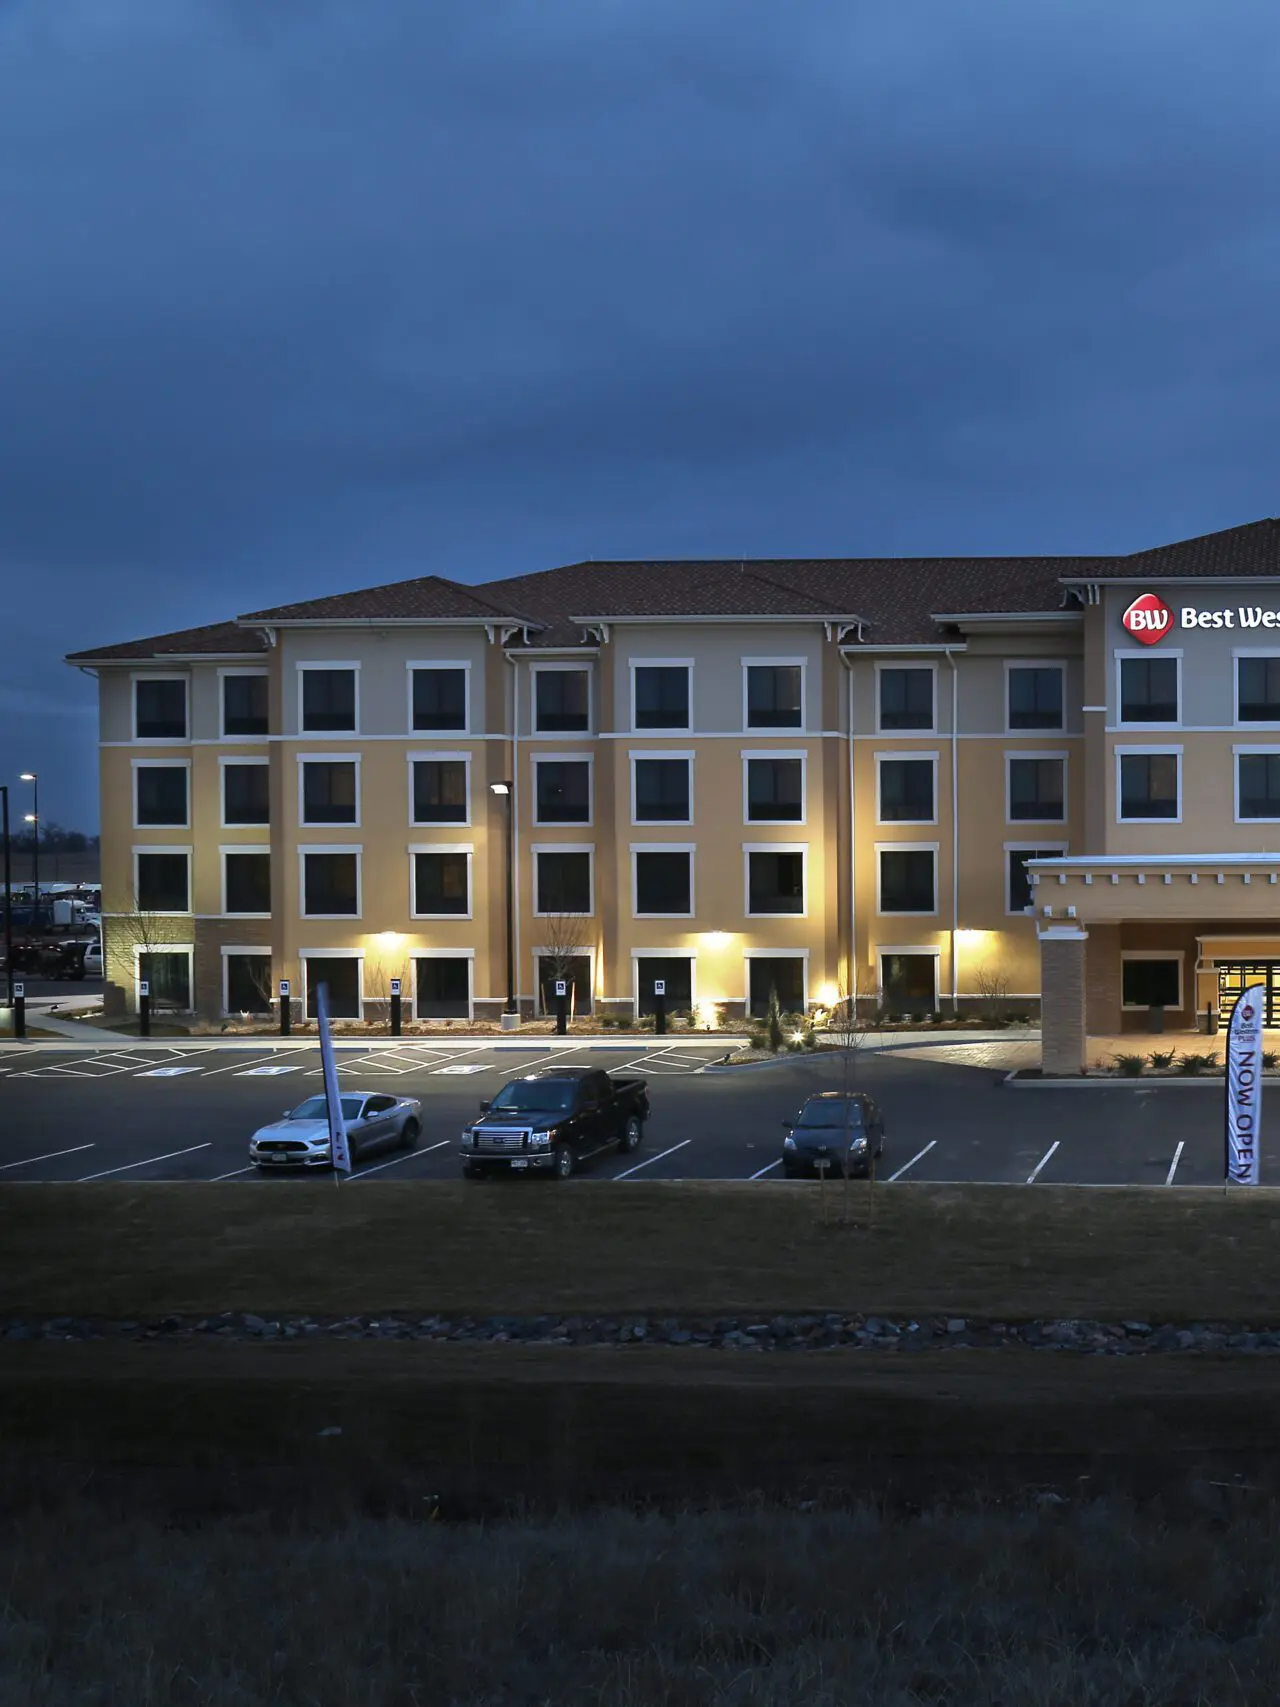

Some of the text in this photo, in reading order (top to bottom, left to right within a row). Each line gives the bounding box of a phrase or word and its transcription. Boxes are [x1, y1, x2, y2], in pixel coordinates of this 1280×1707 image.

[1130, 608, 1169, 630] BW
[1181, 607, 1234, 628] Best
[1237, 1051, 1255, 1107] NOW
[1236, 1114, 1255, 1180] OPEN
